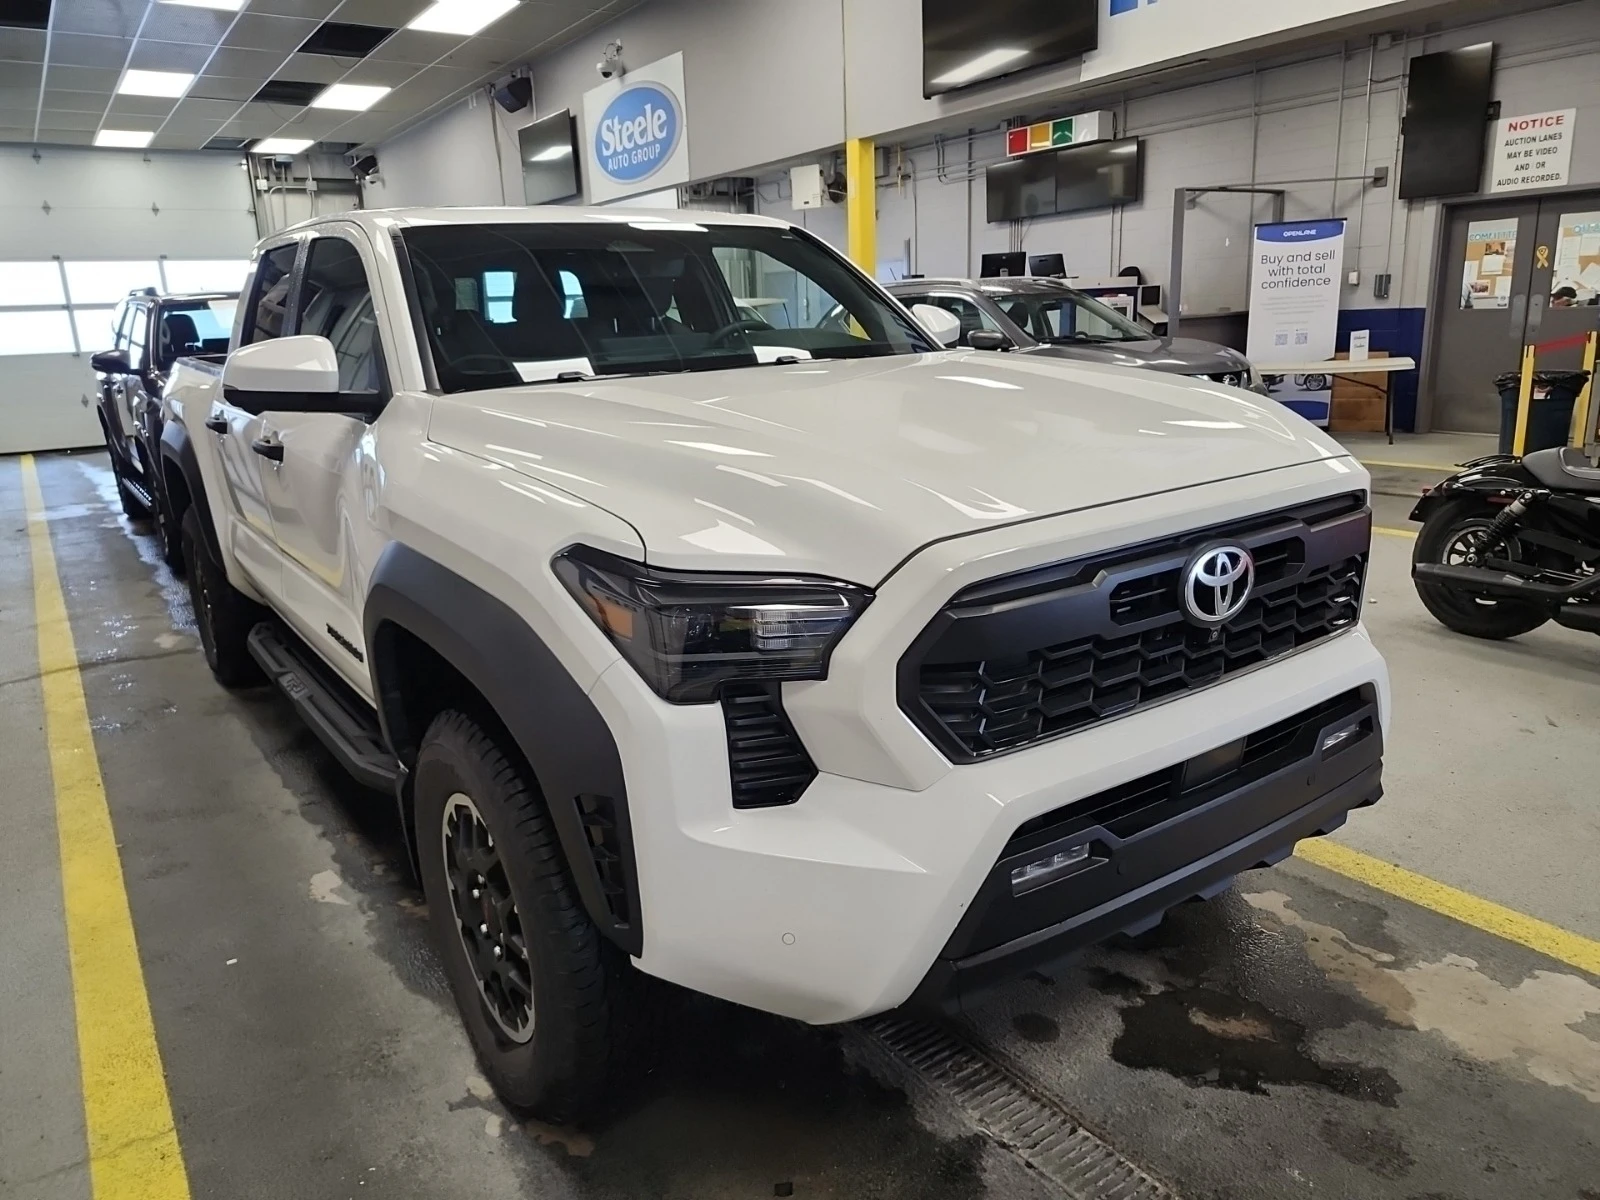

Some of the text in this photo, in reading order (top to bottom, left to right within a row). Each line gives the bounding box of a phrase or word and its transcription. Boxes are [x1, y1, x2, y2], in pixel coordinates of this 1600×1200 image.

[601, 103, 667, 156] Steele
[1508, 115, 1564, 132] NOTICE
[1504, 132, 1563, 147] AUCTION LANES
[608, 143, 661, 171] AUTO GROUP
[1507, 146, 1558, 160] MAY BE VIDEO
[1514, 161, 1546, 172] AND OR
[1497, 172, 1562, 186] AUDIO RECORDED.
[1283, 229, 1317, 237] OPENLANE
[1261, 250, 1335, 266] Buy and sell
[1268, 263, 1326, 277] with total
[1261, 277, 1331, 290] confidence
